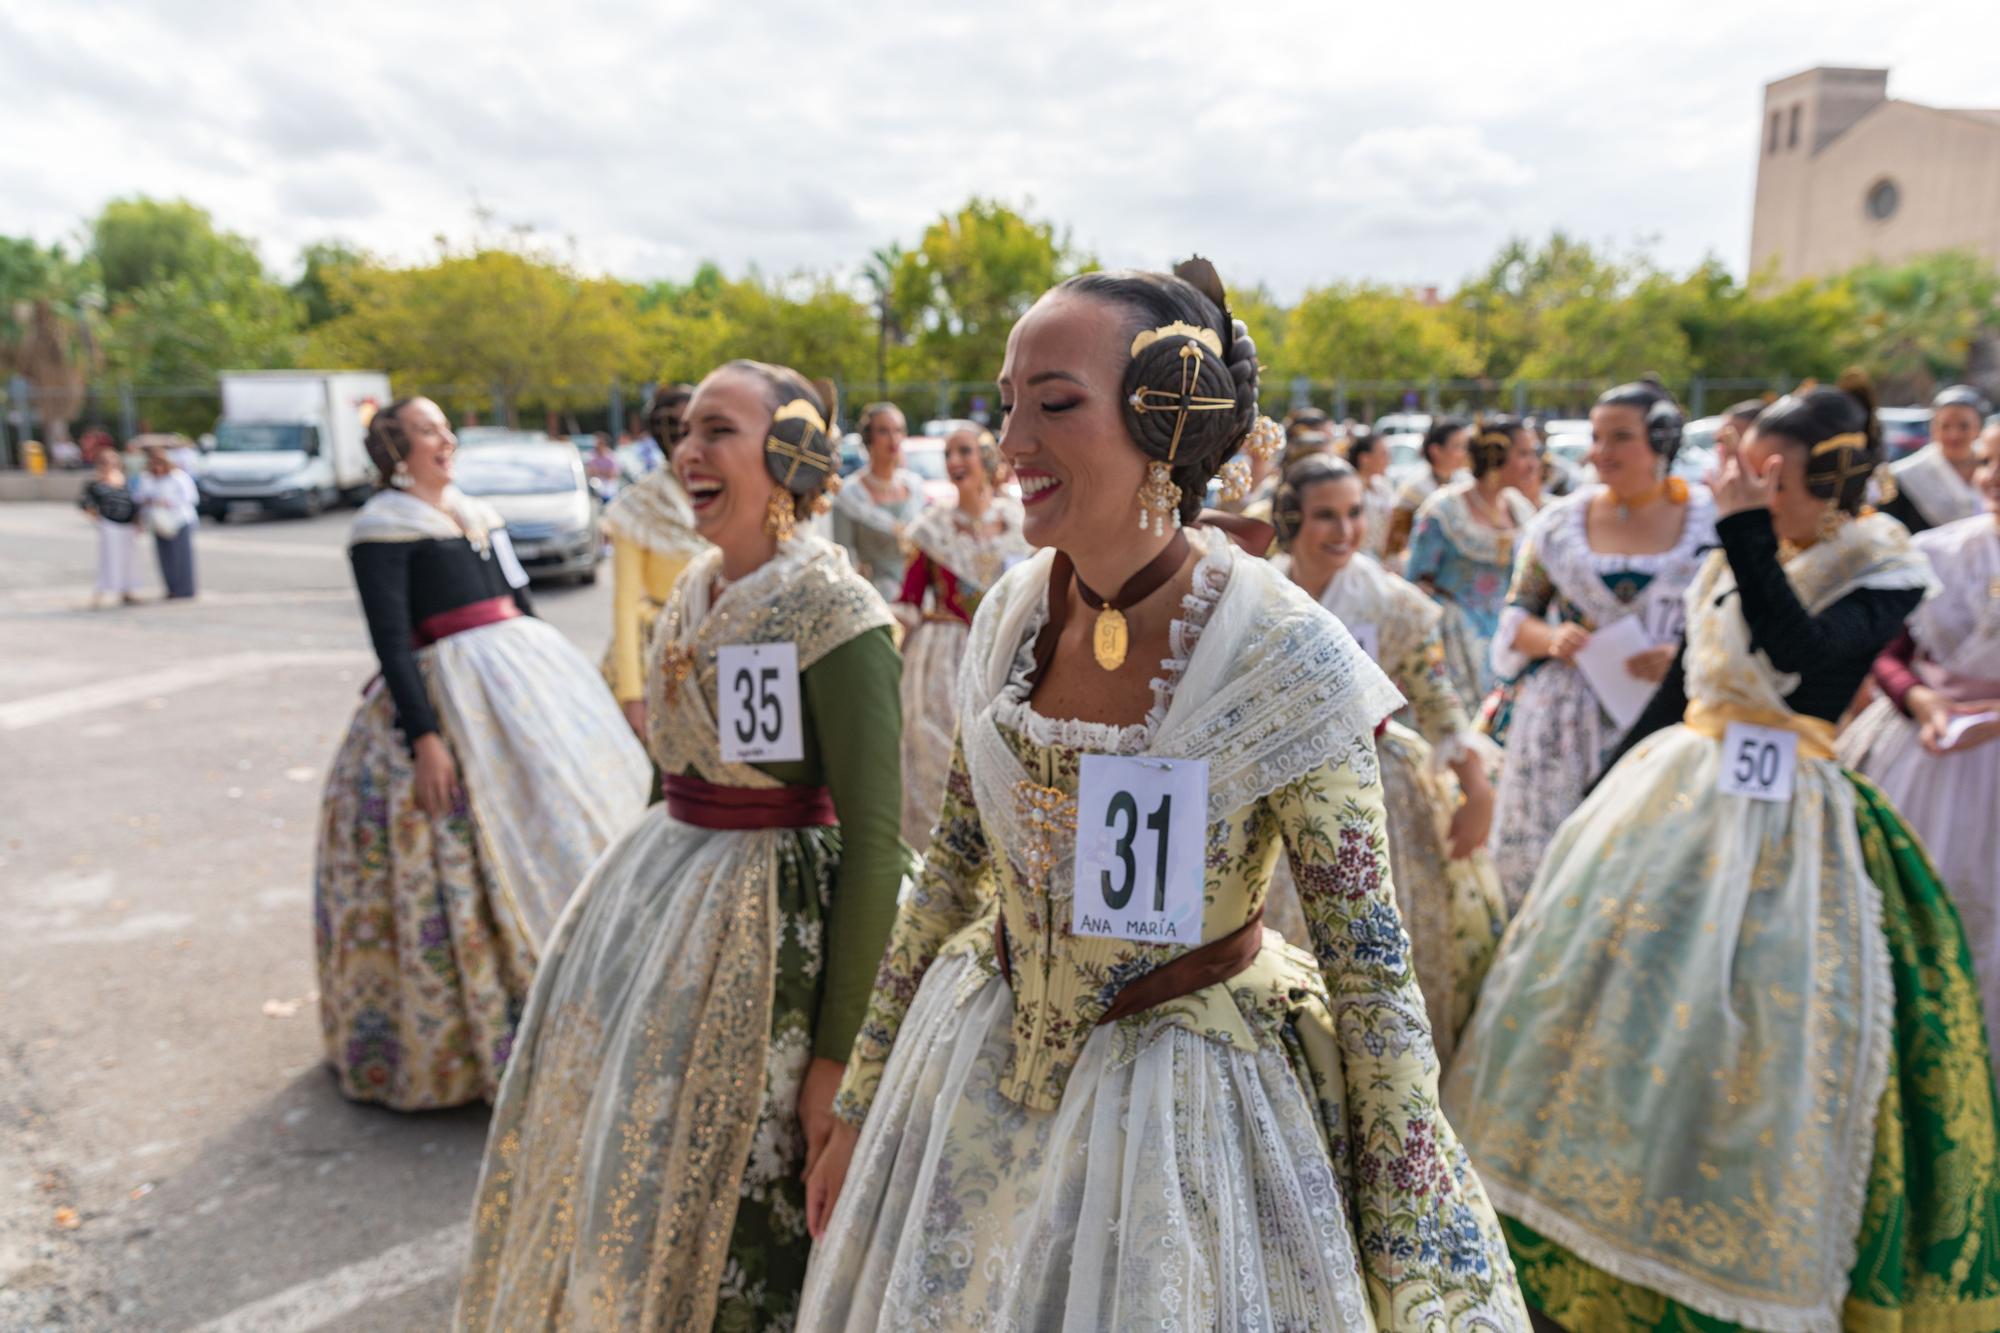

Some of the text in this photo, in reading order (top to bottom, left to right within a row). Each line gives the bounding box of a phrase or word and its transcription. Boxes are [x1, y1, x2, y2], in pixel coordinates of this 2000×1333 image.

[735, 668, 782, 743] 35
[1736, 739, 1779, 786] 50
[1101, 790, 1171, 911] 31
[1081, 914, 1176, 936] ANA MARÍA
